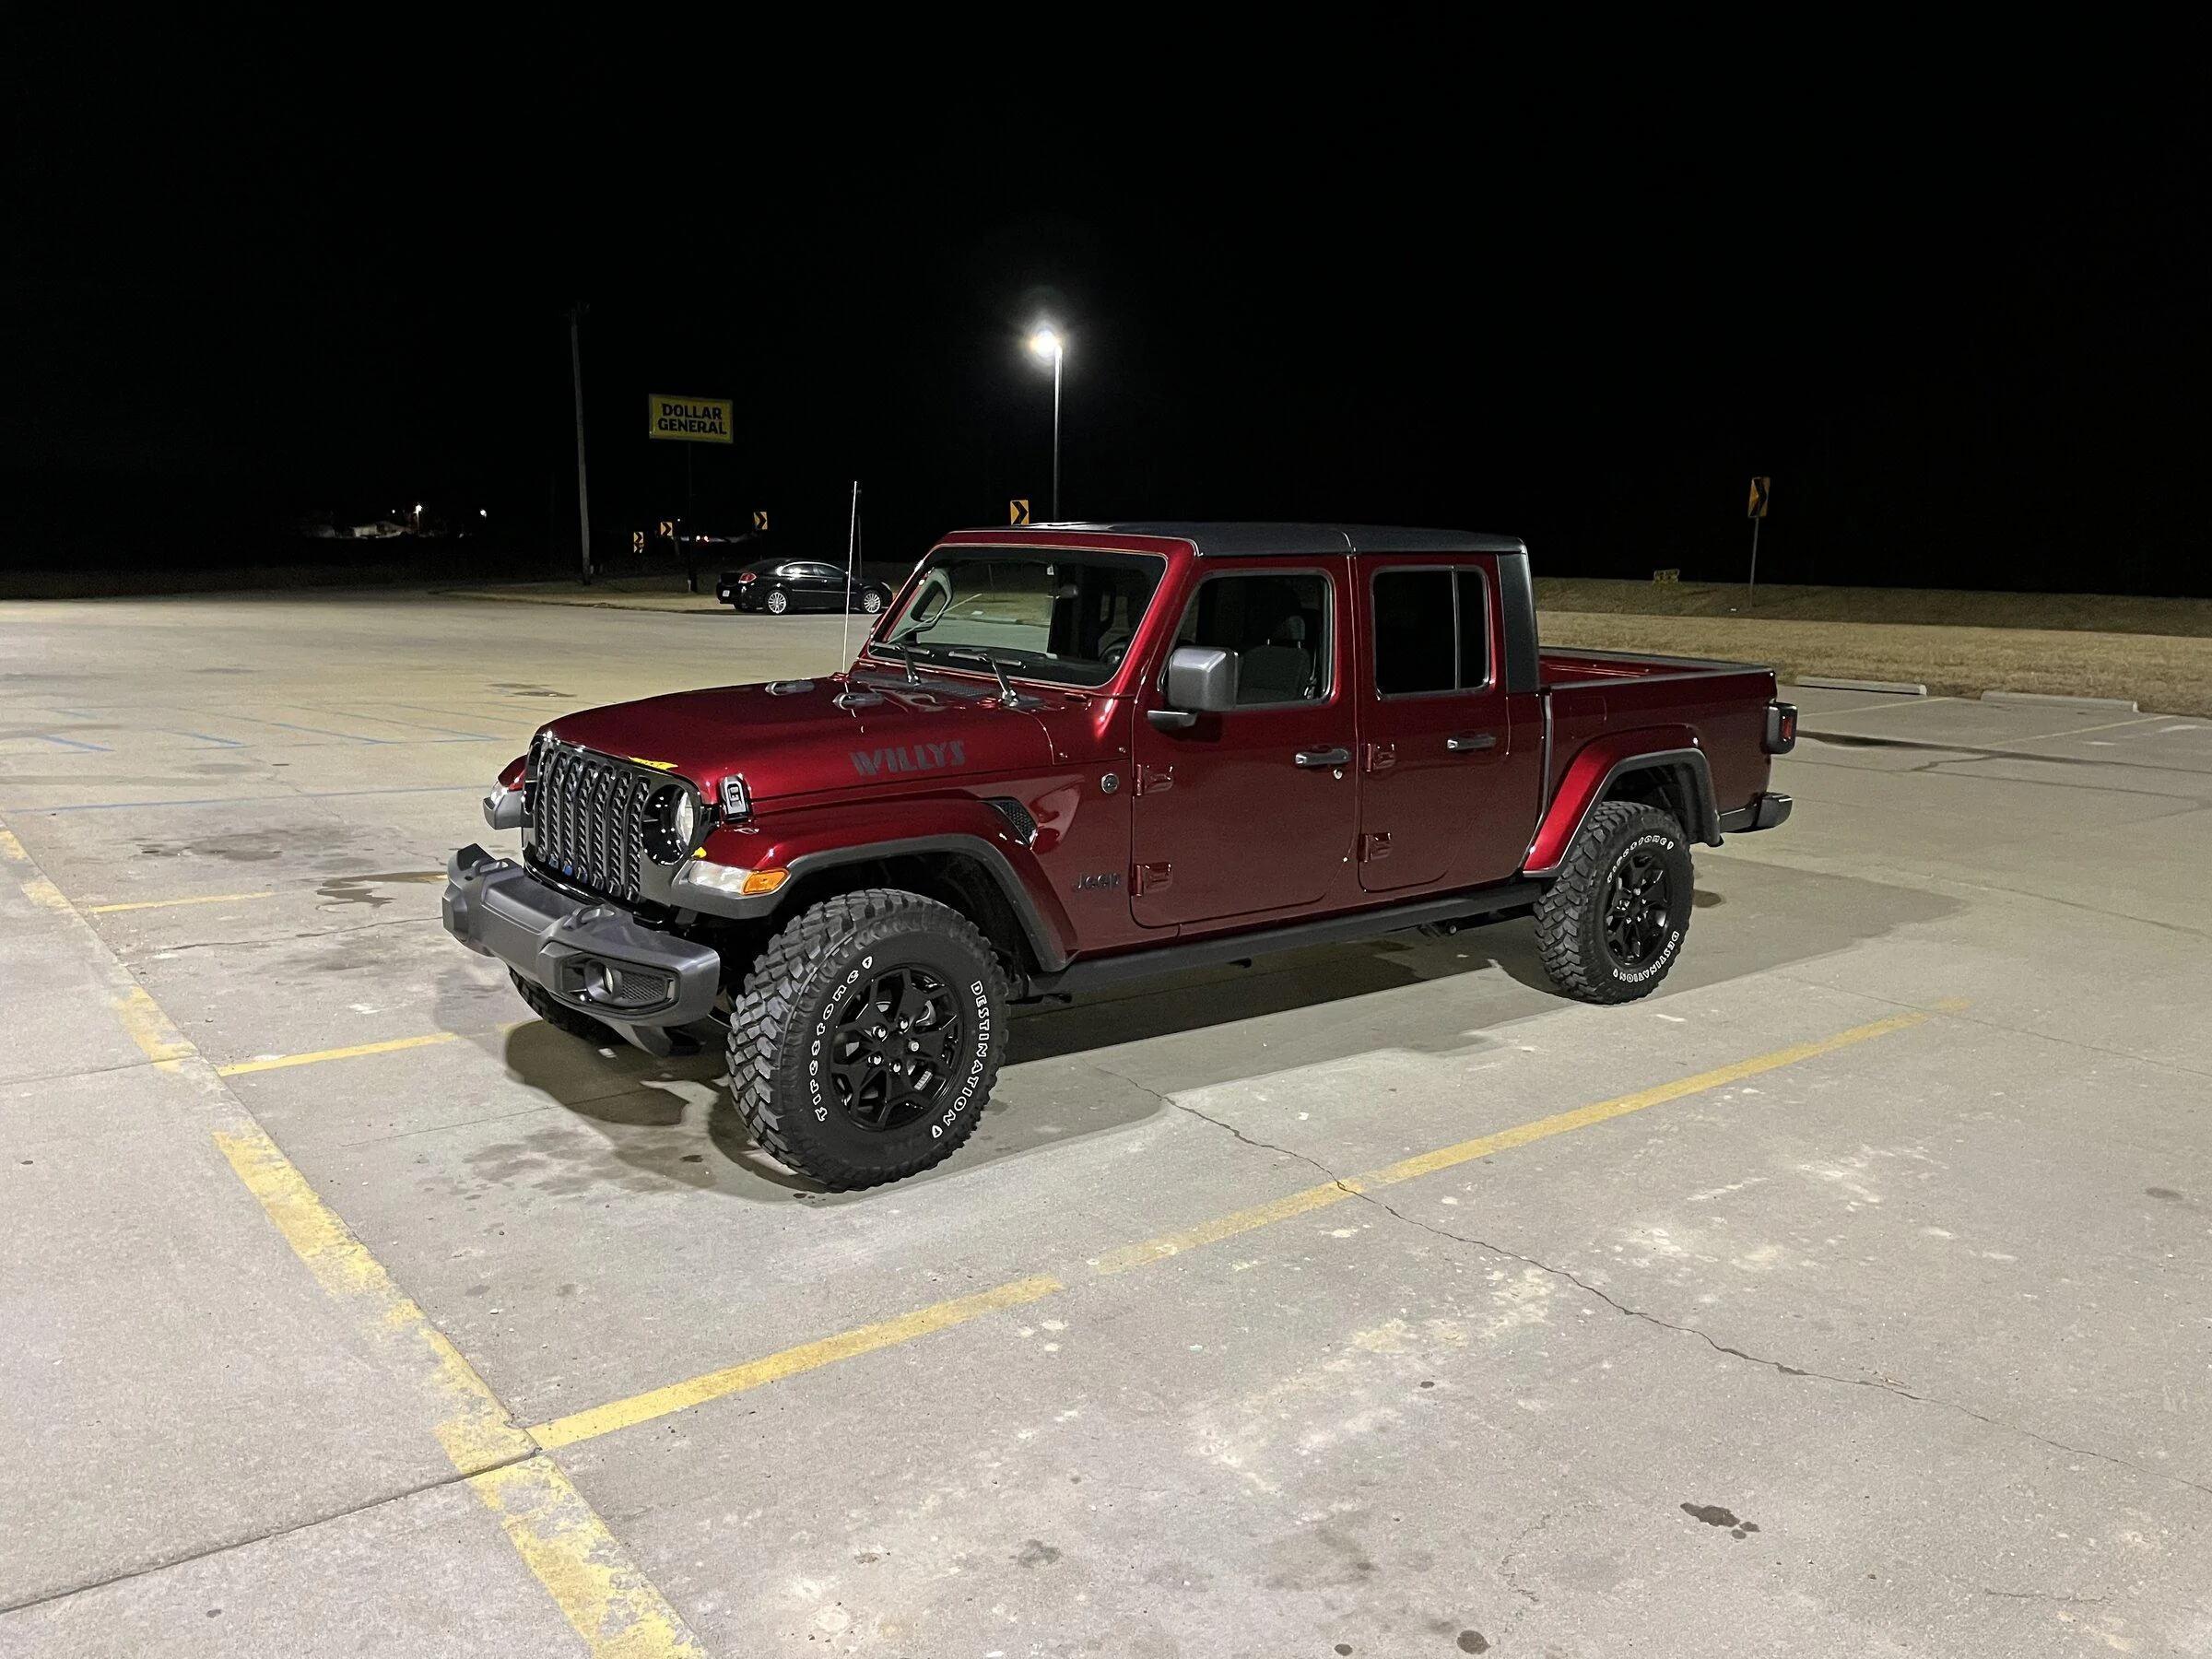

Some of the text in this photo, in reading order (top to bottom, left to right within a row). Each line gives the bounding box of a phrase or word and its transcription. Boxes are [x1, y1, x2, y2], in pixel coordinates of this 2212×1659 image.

[661, 403, 723, 419] DOLLAR
[657, 418, 726, 435] GENERAL
[849, 741, 965, 776] WILLYS
[1074, 872, 1120, 892] Jeep
[1619, 931, 1680, 983] DESTINATION
[942, 980, 990, 1127] DESTINATION
